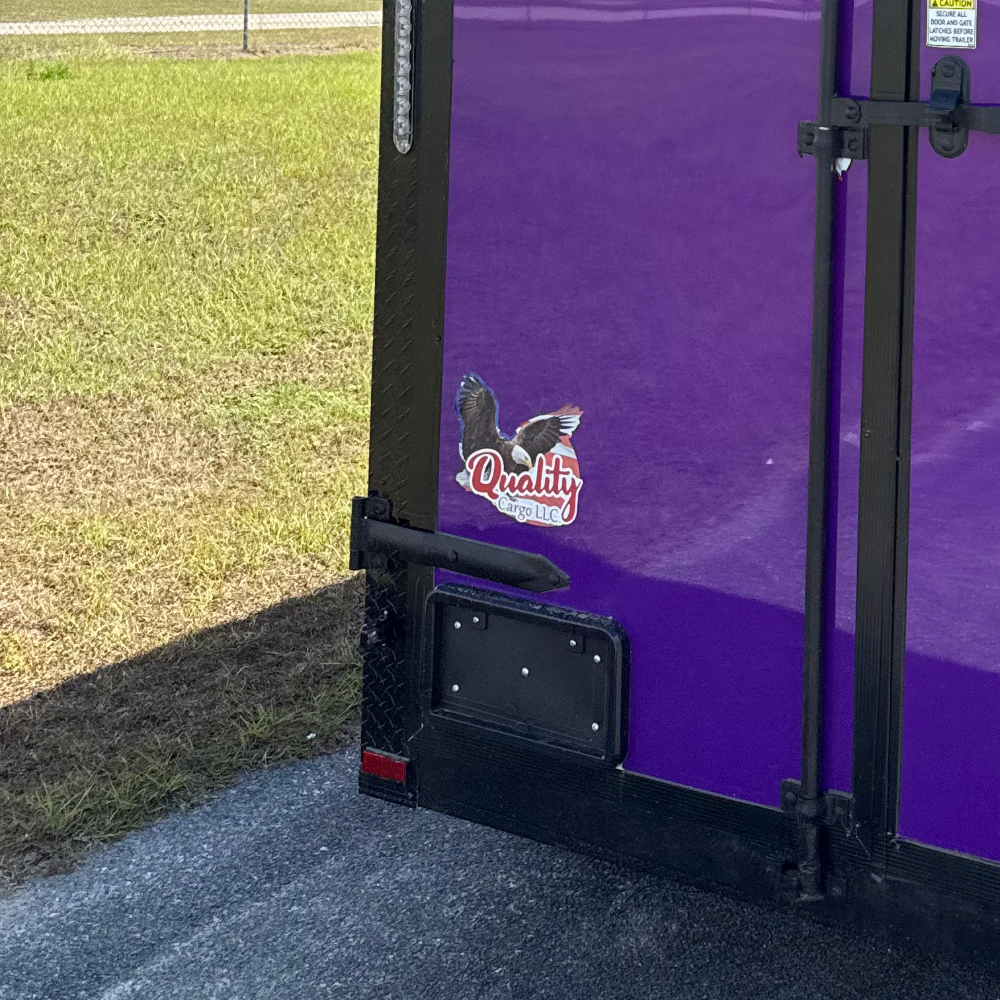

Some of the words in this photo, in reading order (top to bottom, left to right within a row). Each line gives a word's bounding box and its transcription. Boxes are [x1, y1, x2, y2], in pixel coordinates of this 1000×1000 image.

[939, 0, 972, 7] CAUTION
[468, 451, 579, 522] Quality
[498, 496, 532, 520] Cargo
